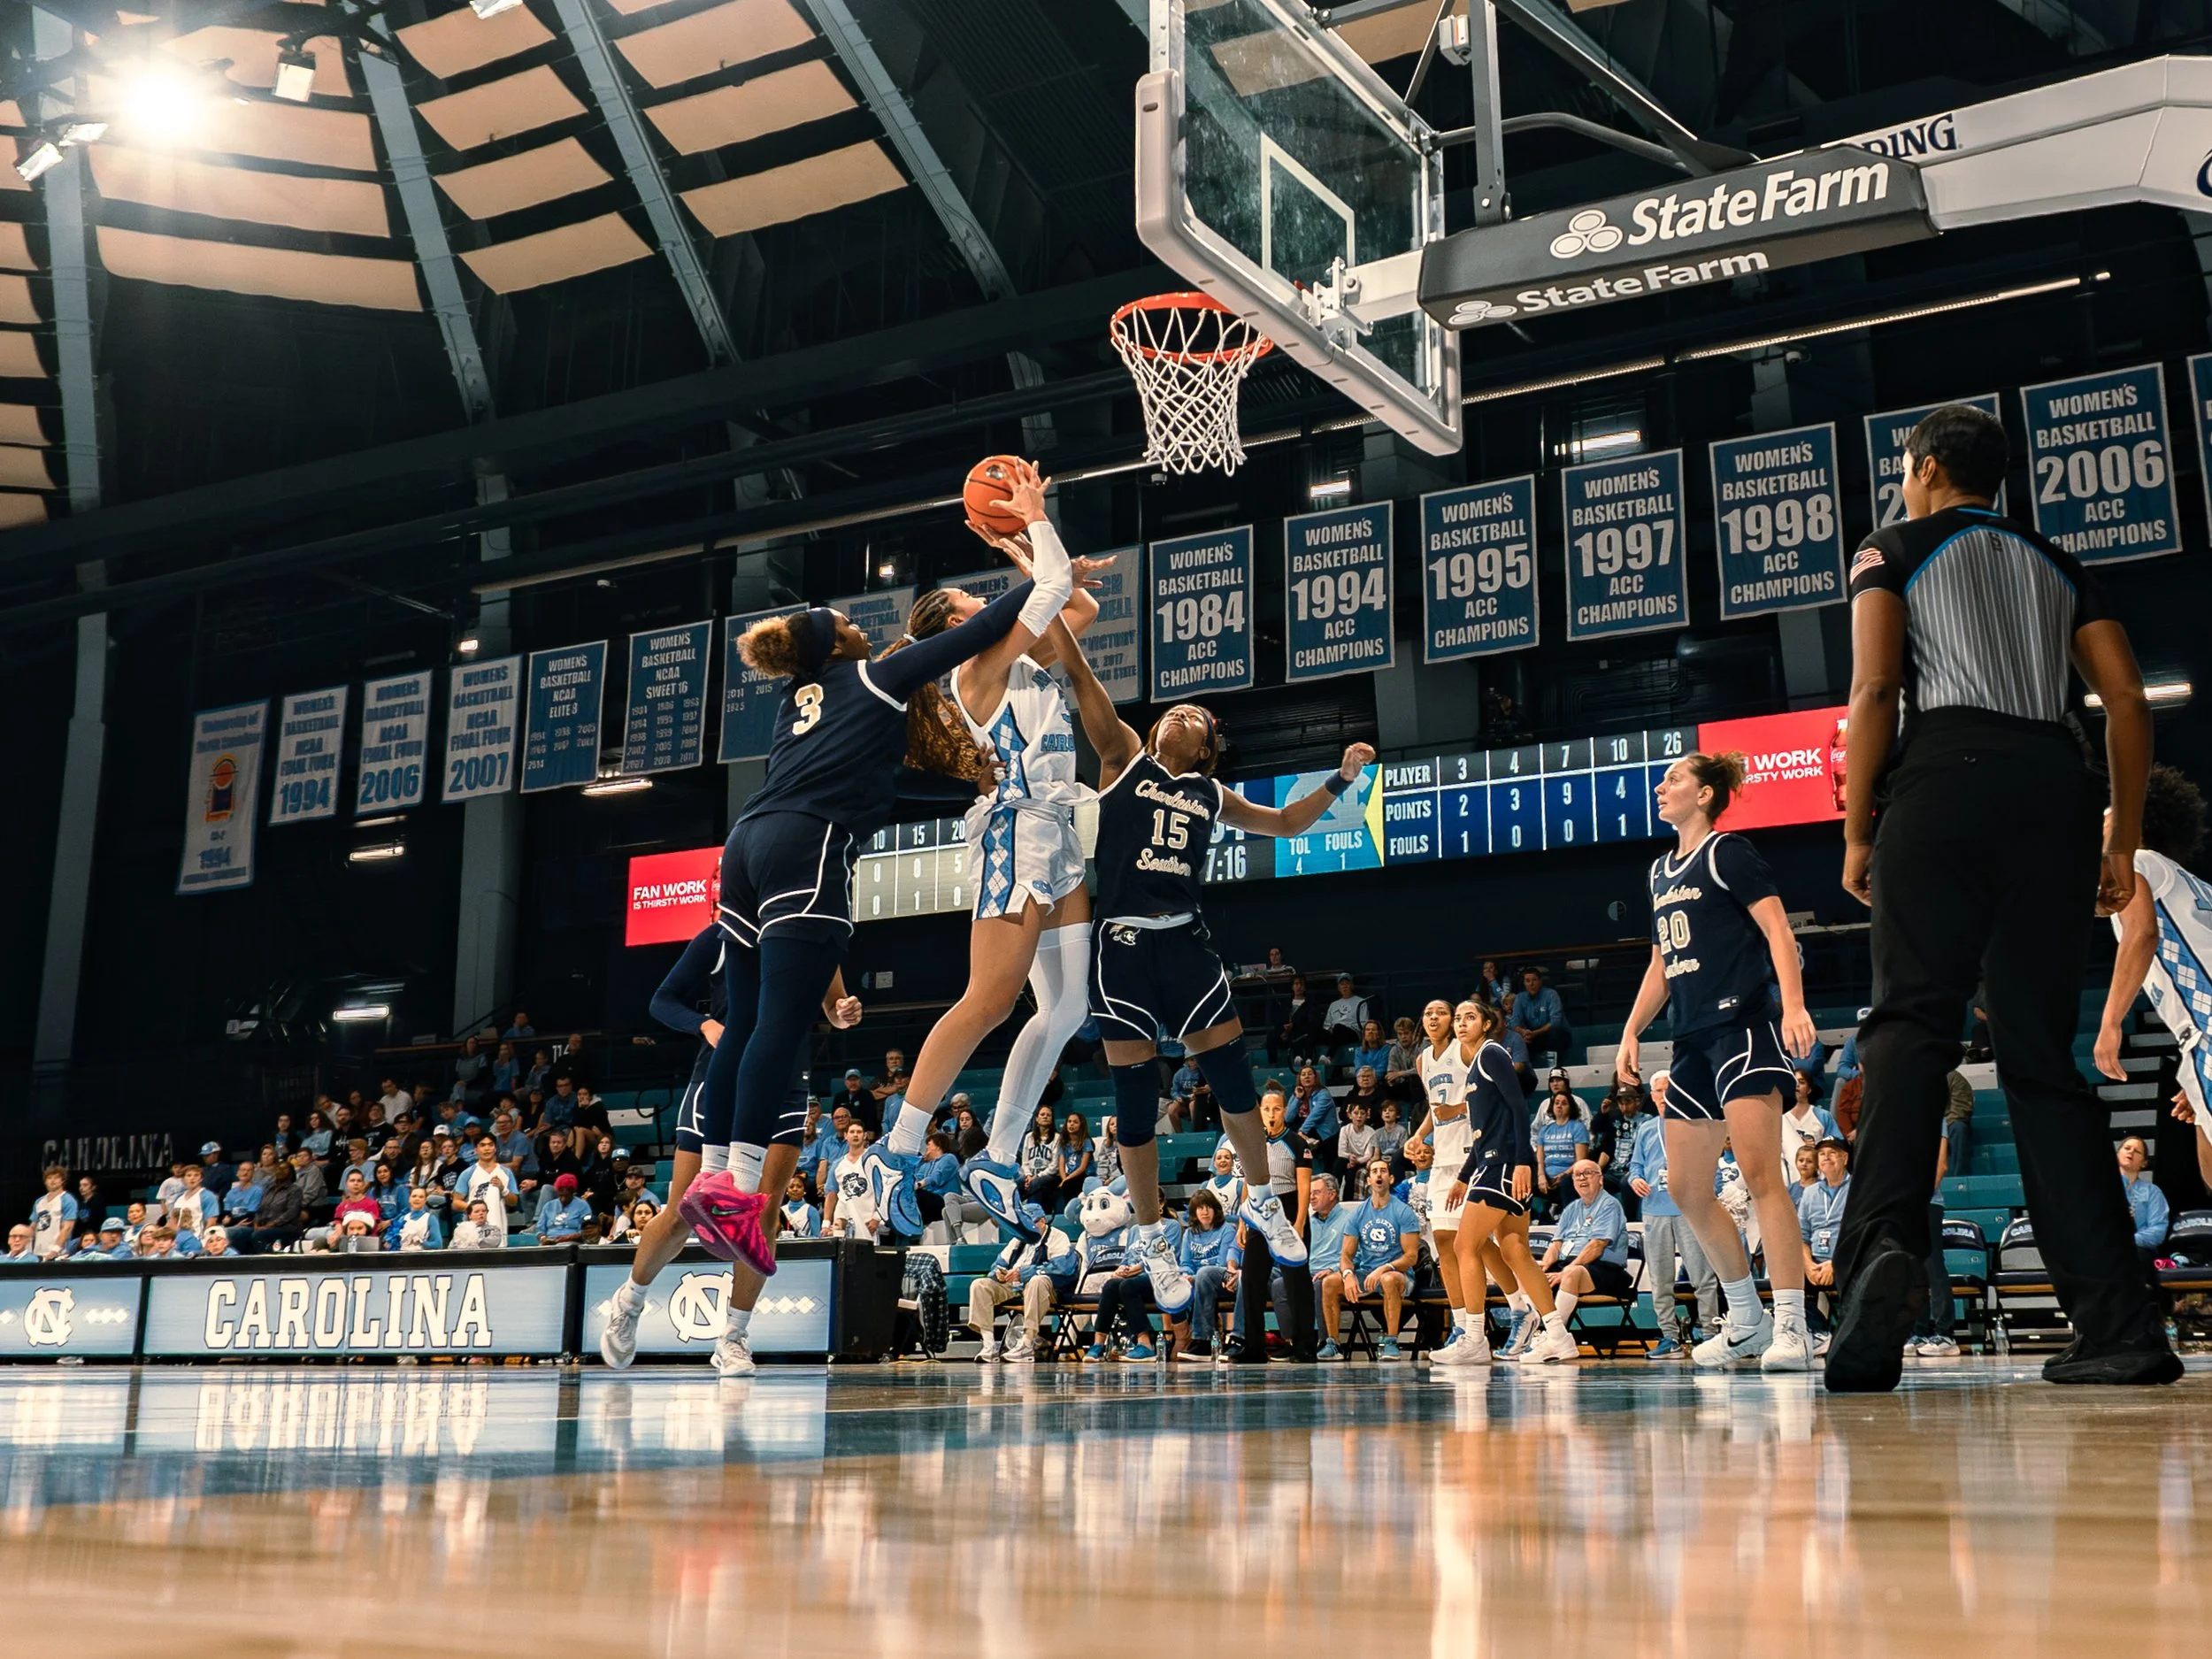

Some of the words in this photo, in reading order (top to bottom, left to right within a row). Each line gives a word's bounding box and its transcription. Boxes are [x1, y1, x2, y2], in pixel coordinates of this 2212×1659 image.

[2048, 383, 2138, 419] WOMEN'S
[2037, 411, 2156, 449] BASKETBALL
[1735, 441, 1813, 472] WOMEN'S
[2037, 440, 2165, 504] 2006
[1584, 466, 1660, 499] WOMEN'S
[1723, 468, 1828, 501] BASKETBALL
[1441, 491, 1514, 524] WOMEN'S
[1572, 493, 1674, 526] BASKETBALL
[2085, 498, 2125, 523] ACC
[1305, 517, 1372, 547] WOMEN'S
[1431, 518, 1526, 551] BASKETBALL
[1721, 494, 1834, 555] 1998
[1170, 541, 1233, 570] WOMEN'S
[1293, 543, 1384, 572] BASKETBALL
[1574, 518, 1675, 577] 1997
[1763, 550, 1799, 574] ACC
[1158, 566, 1244, 595] BASKETBALL
[1429, 542, 1531, 600] 1995
[1609, 574, 1644, 595] ACC
[1291, 567, 1386, 621] 1994
[1731, 571, 1835, 604] CHAMPIONS
[1156, 590, 1245, 643] 1984
[1464, 596, 1498, 618] ACC
[1578, 595, 1678, 626] CHAMPIONS
[1325, 618, 1356, 640] ACC
[1434, 616, 1530, 649] CHAMPIONS
[641, 648, 695, 668] BASKETBALL
[1187, 640, 1217, 661] ACC
[1295, 638, 1384, 668] CHAMPIONS
[540, 670, 591, 689] BASKETBALL
[655, 666, 680, 681] NCAA
[1160, 658, 1245, 688] CHAMPIONS
[553, 687, 575, 703] NCAA
[646, 683, 677, 699] SWEET
[678, 681, 688, 694] 16
[549, 704, 571, 718] ELITE
[572, 703, 578, 715] 8
[792, 682, 824, 735] 3
[449, 751, 510, 793] 2007
[1385, 764, 1431, 787] PLAYER
[1457, 757, 1468, 780] 3
[1509, 750, 1519, 774] 4
[1562, 744, 1571, 768] 7
[1610, 738, 1629, 763] 10
[1663, 731, 1682, 757] 26
[1745, 772, 1778, 784] RSTY
[1781, 765, 1824, 780] WORK
[1754, 748, 1823, 771] WORK
[280, 777, 332, 815] 1994
[359, 764, 420, 804] 2006
[1386, 800, 1432, 822] POINTS
[1459, 795, 1469, 817] 2
[1510, 787, 1520, 811] 3
[1563, 781, 1572, 805] 9
[1616, 775, 1625, 799] 4
[1134, 779, 1210, 821] Charleston
[872, 829, 886, 850] 10
[912, 825, 926, 845] 15
[951, 819, 965, 841] 20
[1152, 809, 1190, 849] 15
[1288, 837, 1311, 856] TOL
[1325, 831, 1363, 851] FOULS
[1389, 834, 1429, 856] FOULS
[1461, 831, 1469, 853] 1
[1512, 825, 1521, 849] 0
[1564, 819, 1574, 842] 0
[1618, 813, 1627, 836] 1
[955, 853, 962, 873] 5
[1205, 845, 1247, 882] 7:16
[1295, 856, 1303, 874] 4
[1340, 853, 1346, 871] 1
[634, 885, 660, 900] FAN
[663, 879, 707, 897] WORK
[634, 902, 641, 910] IS
[642, 897, 678, 909] THIRSTY
[679, 894, 706, 905] WORK
[873, 895, 880, 916] 0
[914, 890, 920, 910] 1
[954, 886, 961, 906] 0
[1657, 910, 1691, 955] 20
[1438, 1088, 1447, 1104] 7
[42, 1133, 173, 1171] CAROLINA
[1028, 1145, 1052, 1161] UNC
[204, 1273, 493, 1349] CAROLINA
